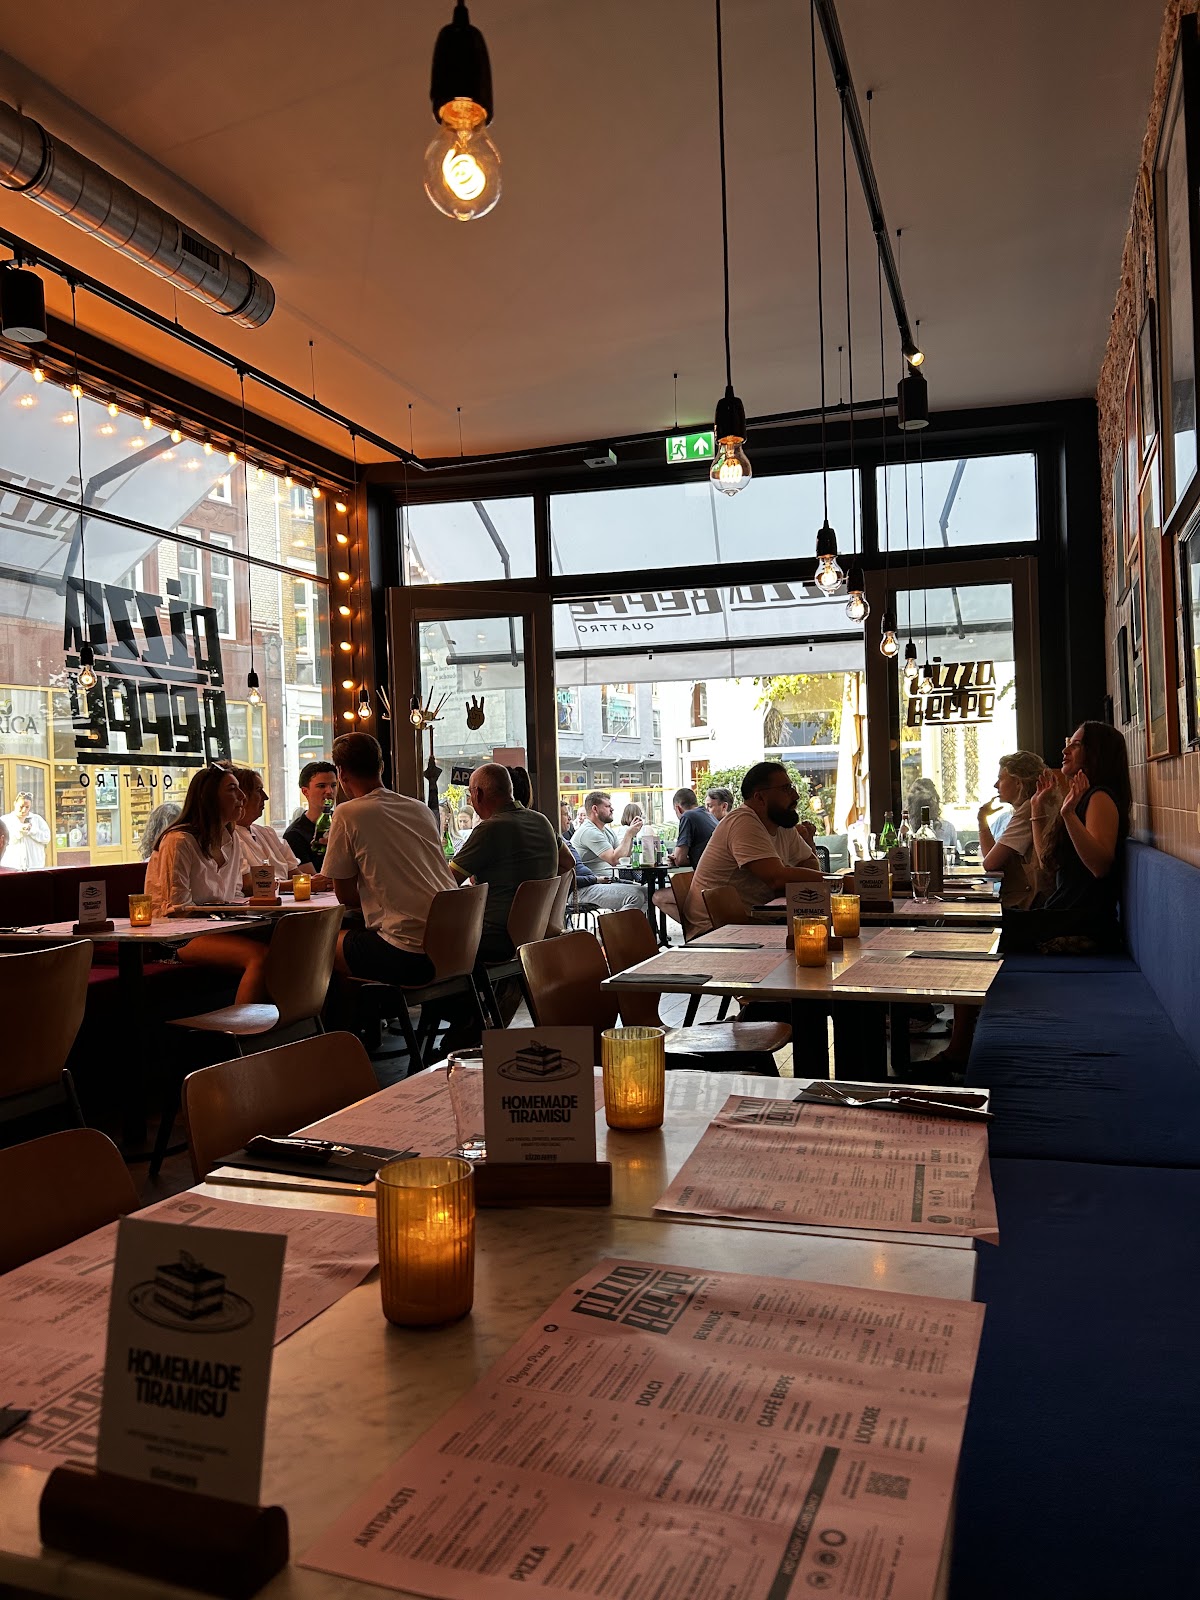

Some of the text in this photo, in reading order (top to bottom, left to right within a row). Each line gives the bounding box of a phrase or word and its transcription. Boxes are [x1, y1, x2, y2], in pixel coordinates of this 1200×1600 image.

[502, 1095, 578, 1109] HOMEMADE
[509, 1109, 571, 1123] TIRAMISU
[693, 1278, 721, 1311] QUATTRO
[693, 1310, 724, 1341] BEVANDE
[127, 1348, 242, 1392] HOMEMADE
[506, 1360, 535, 1384] Vegan
[527, 1344, 552, 1364] Pizza
[135, 1376, 228, 1418] TIRAMISU
[635, 1380, 664, 1407] DOLCI
[769, 1374, 796, 1402] BEPPE
[854, 1405, 881, 1444] LIQUORE
[354, 1487, 417, 1549] ANTIPASTI
[509, 1545, 550, 1582] PIZZA
